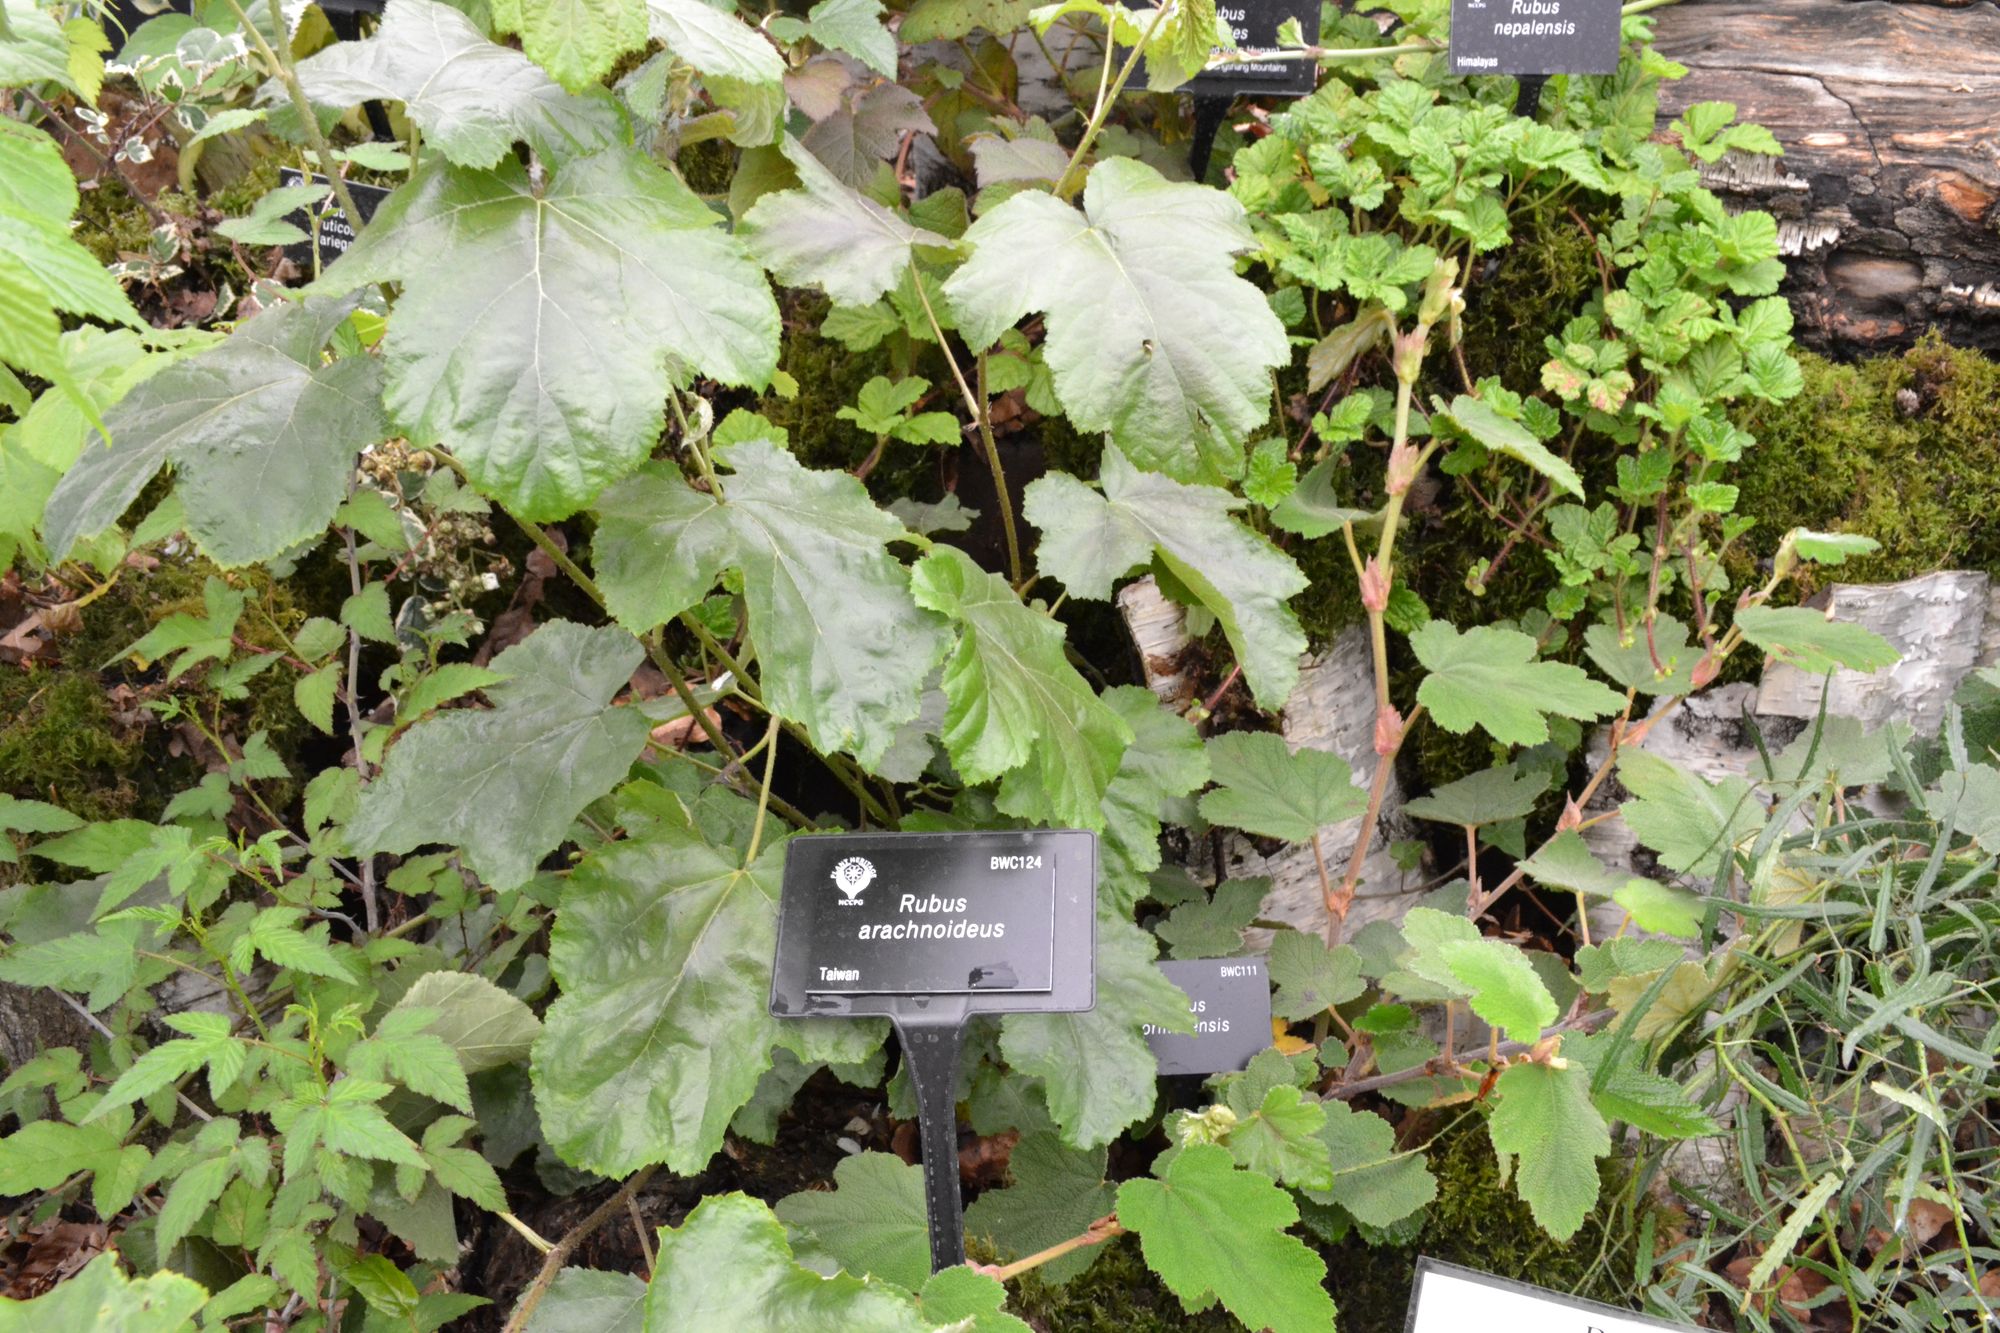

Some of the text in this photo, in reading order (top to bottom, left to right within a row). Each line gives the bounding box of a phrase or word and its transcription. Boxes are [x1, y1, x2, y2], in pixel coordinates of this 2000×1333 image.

[1216, 6, 1246, 21] bus
[1511, 0, 1560, 14] Rubus
[1494, 20, 1576, 38] nepalensis
[1250, 63, 1287, 73] Mountains
[1457, 56, 1498, 68] Himalayas
[990, 855, 1042, 870] BWC124
[838, 898, 864, 906] NCCPG
[899, 894, 967, 913] Rubus
[858, 919, 1005, 940] arachnoideus
[819, 966, 860, 982] Taiwan
[1220, 965, 1257, 977] BWC111
